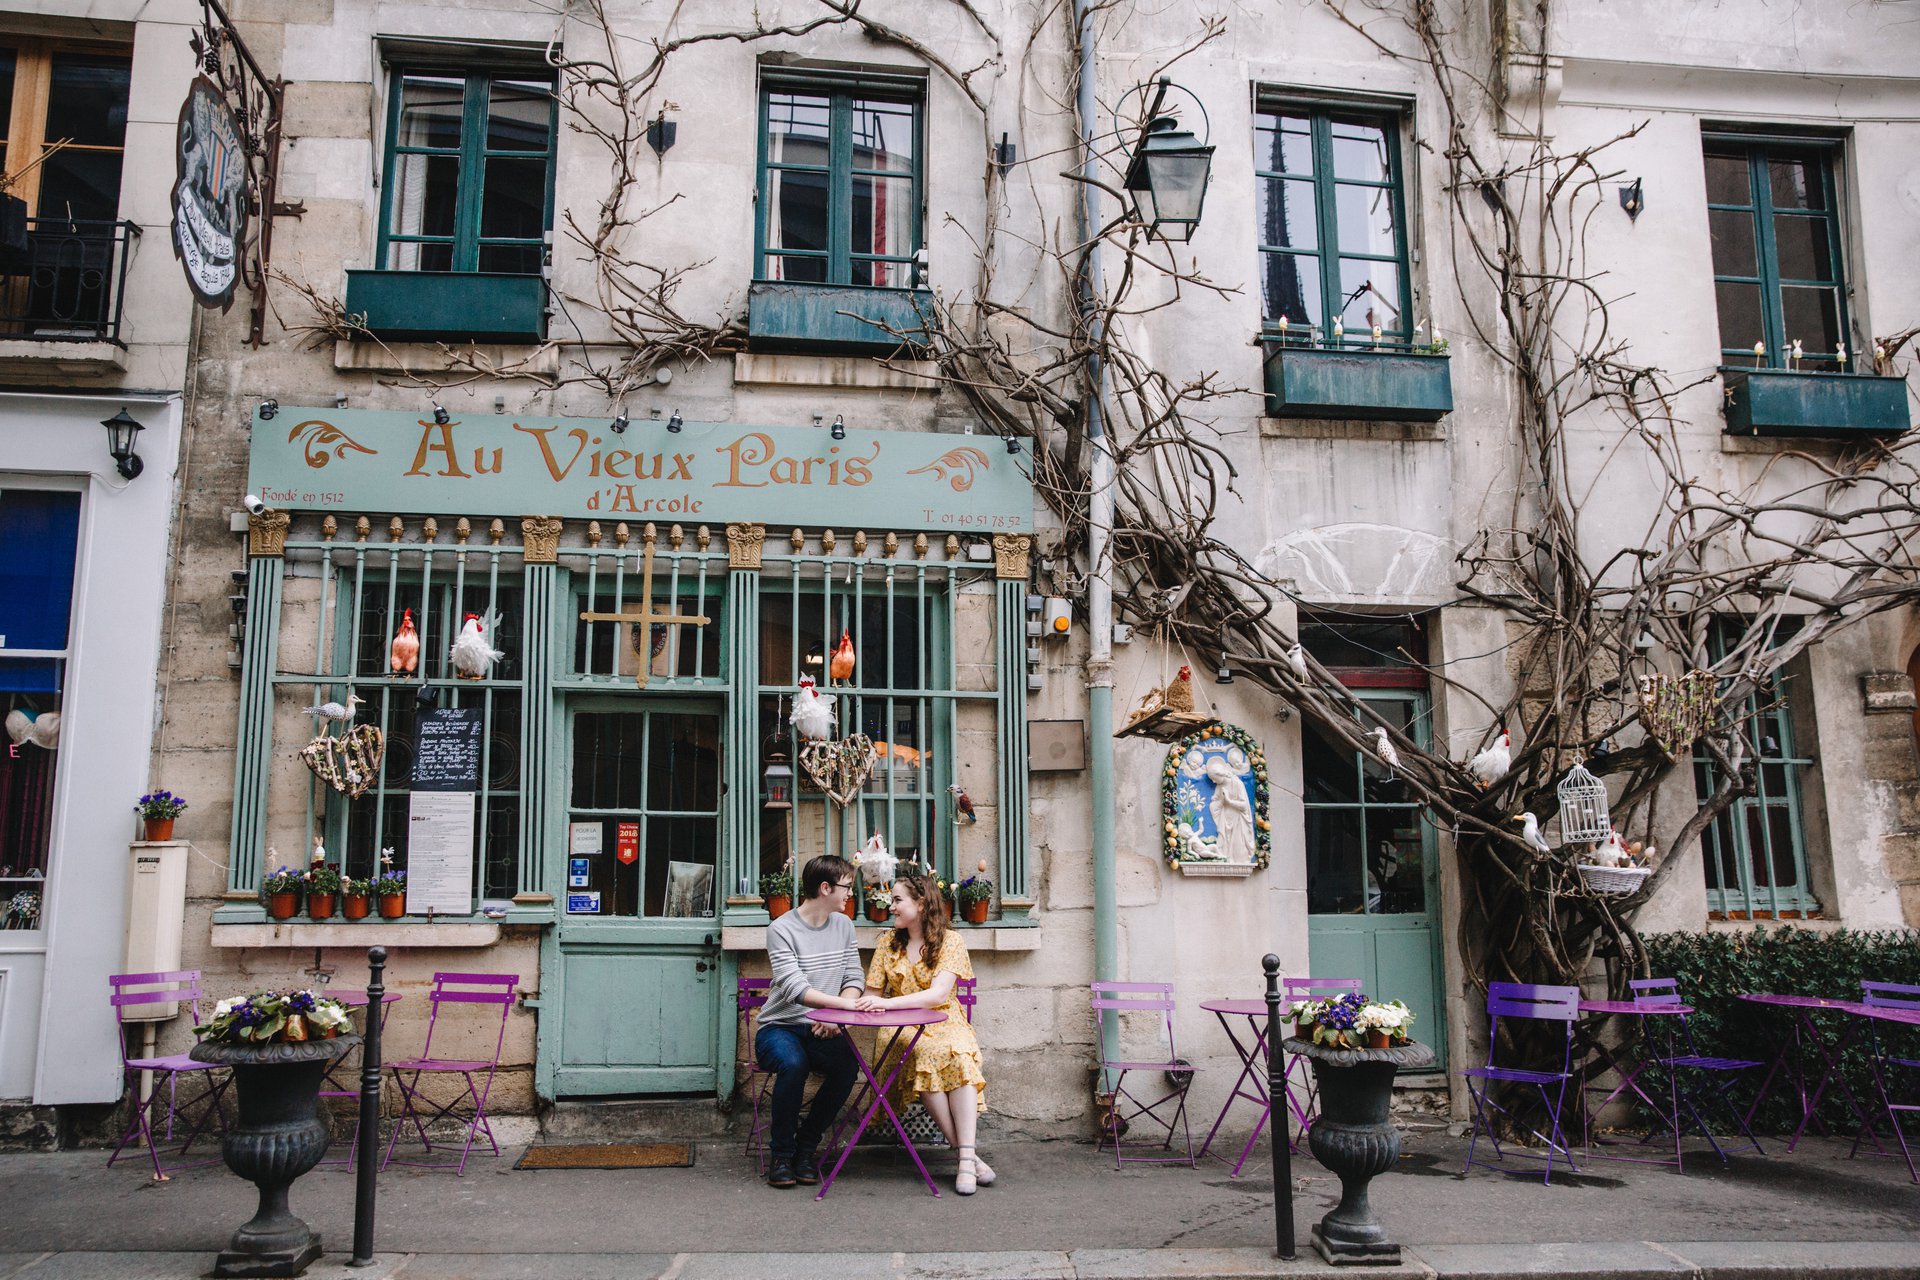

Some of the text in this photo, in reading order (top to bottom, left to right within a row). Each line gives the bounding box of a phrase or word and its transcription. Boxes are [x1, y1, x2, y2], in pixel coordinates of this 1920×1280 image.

[403, 419, 881, 488] Au Vieux Paris
[258, 486, 345, 507] Fondé en 1512
[586, 483, 703, 513] d'Arcole
[941, 514, 954, 524] 01
[957, 514, 973, 526] 40
[976, 515, 988, 527] 51
[991, 515, 1005, 527] 78
[1007, 516, 1021, 528] 52
[9, 743, 21, 758] E
